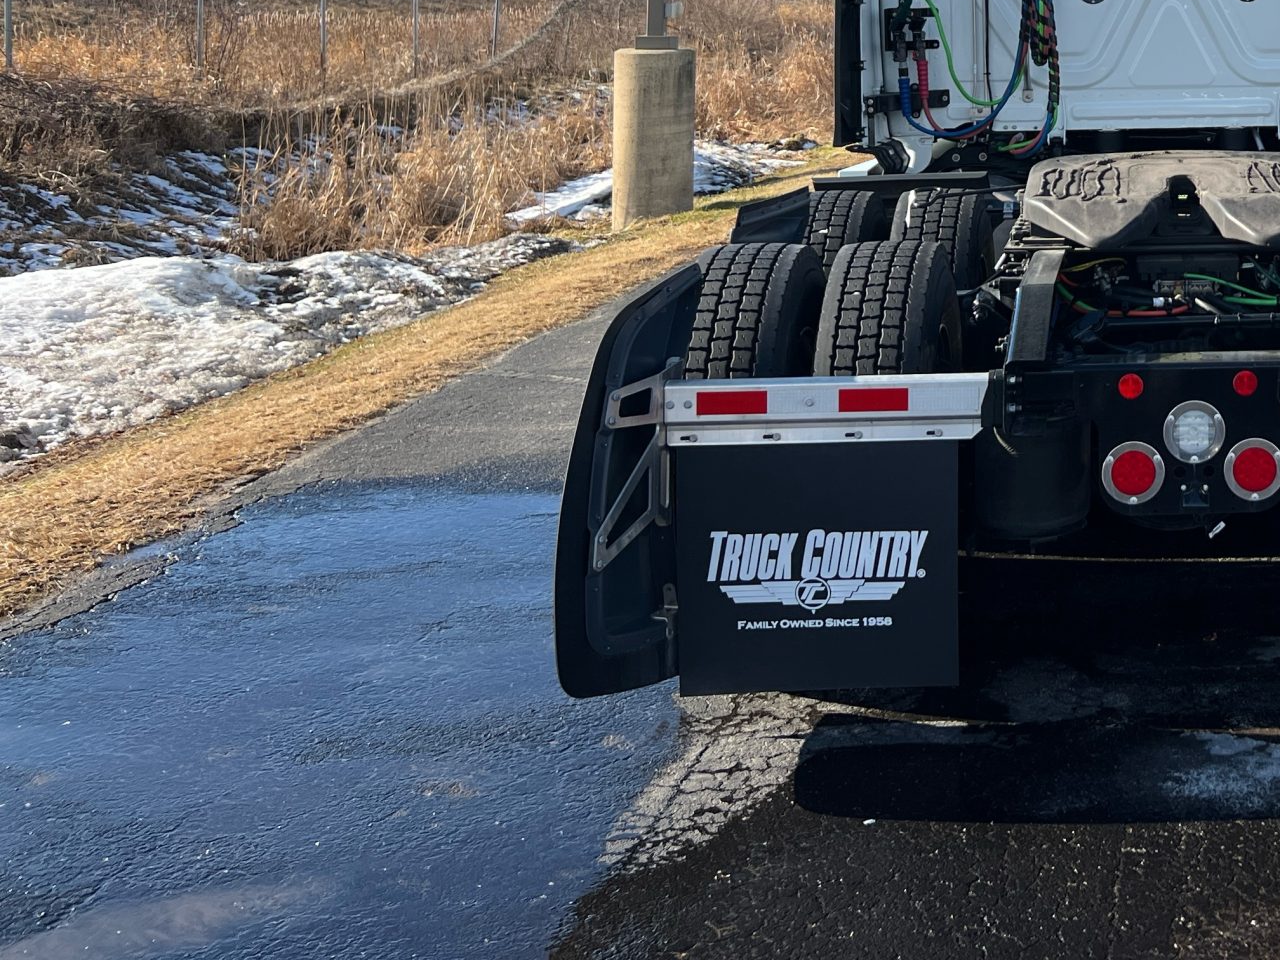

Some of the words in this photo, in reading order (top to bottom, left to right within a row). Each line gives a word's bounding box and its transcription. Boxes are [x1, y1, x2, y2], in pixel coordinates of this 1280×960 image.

[706, 530, 799, 582] TRUCK
[800, 528, 929, 579] COUNTRY
[737, 620, 777, 630] FAMILY
[780, 618, 823, 629] OWNED
[825, 618, 859, 628] SINCE
[862, 616, 893, 626] 1958
